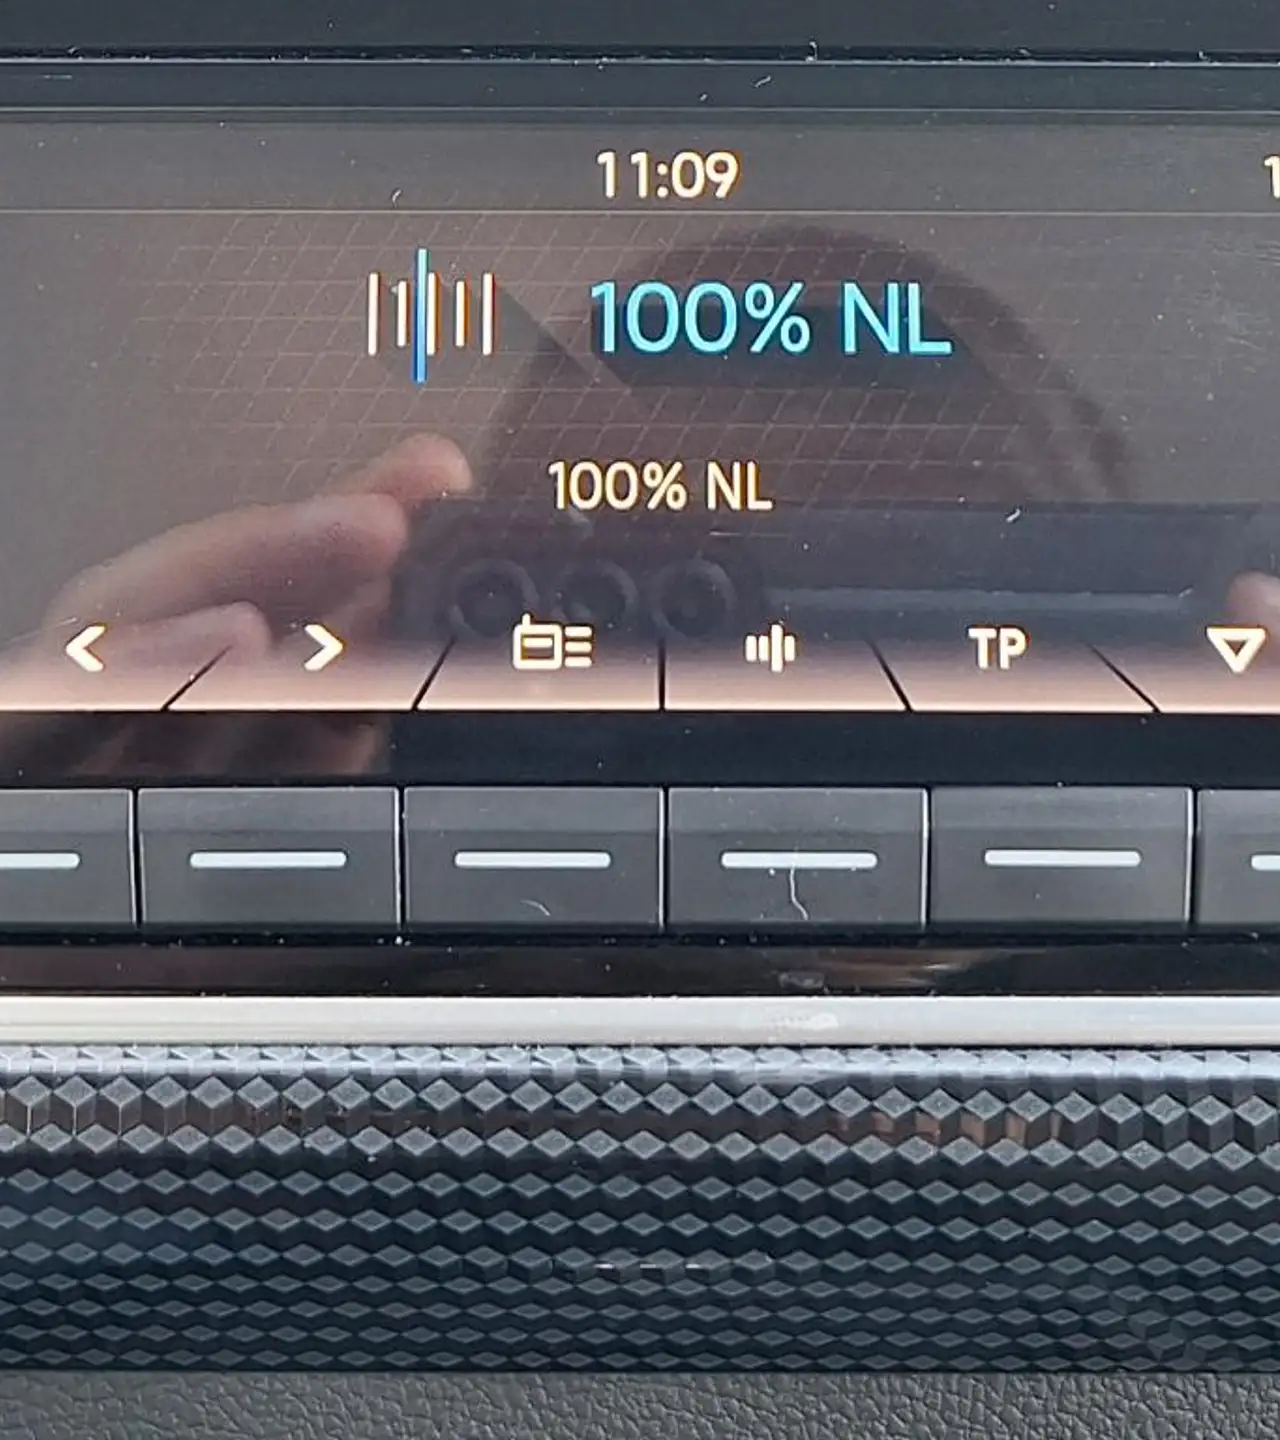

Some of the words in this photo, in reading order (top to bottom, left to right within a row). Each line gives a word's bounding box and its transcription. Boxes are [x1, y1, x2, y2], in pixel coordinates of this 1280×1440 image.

[597, 151, 739, 198] 11:09
[591, 281, 810, 353] 100%
[844, 282, 952, 354] NL
[548, 461, 687, 510] 100%
[707, 461, 773, 510] NL
[968, 627, 1027, 670] TP
